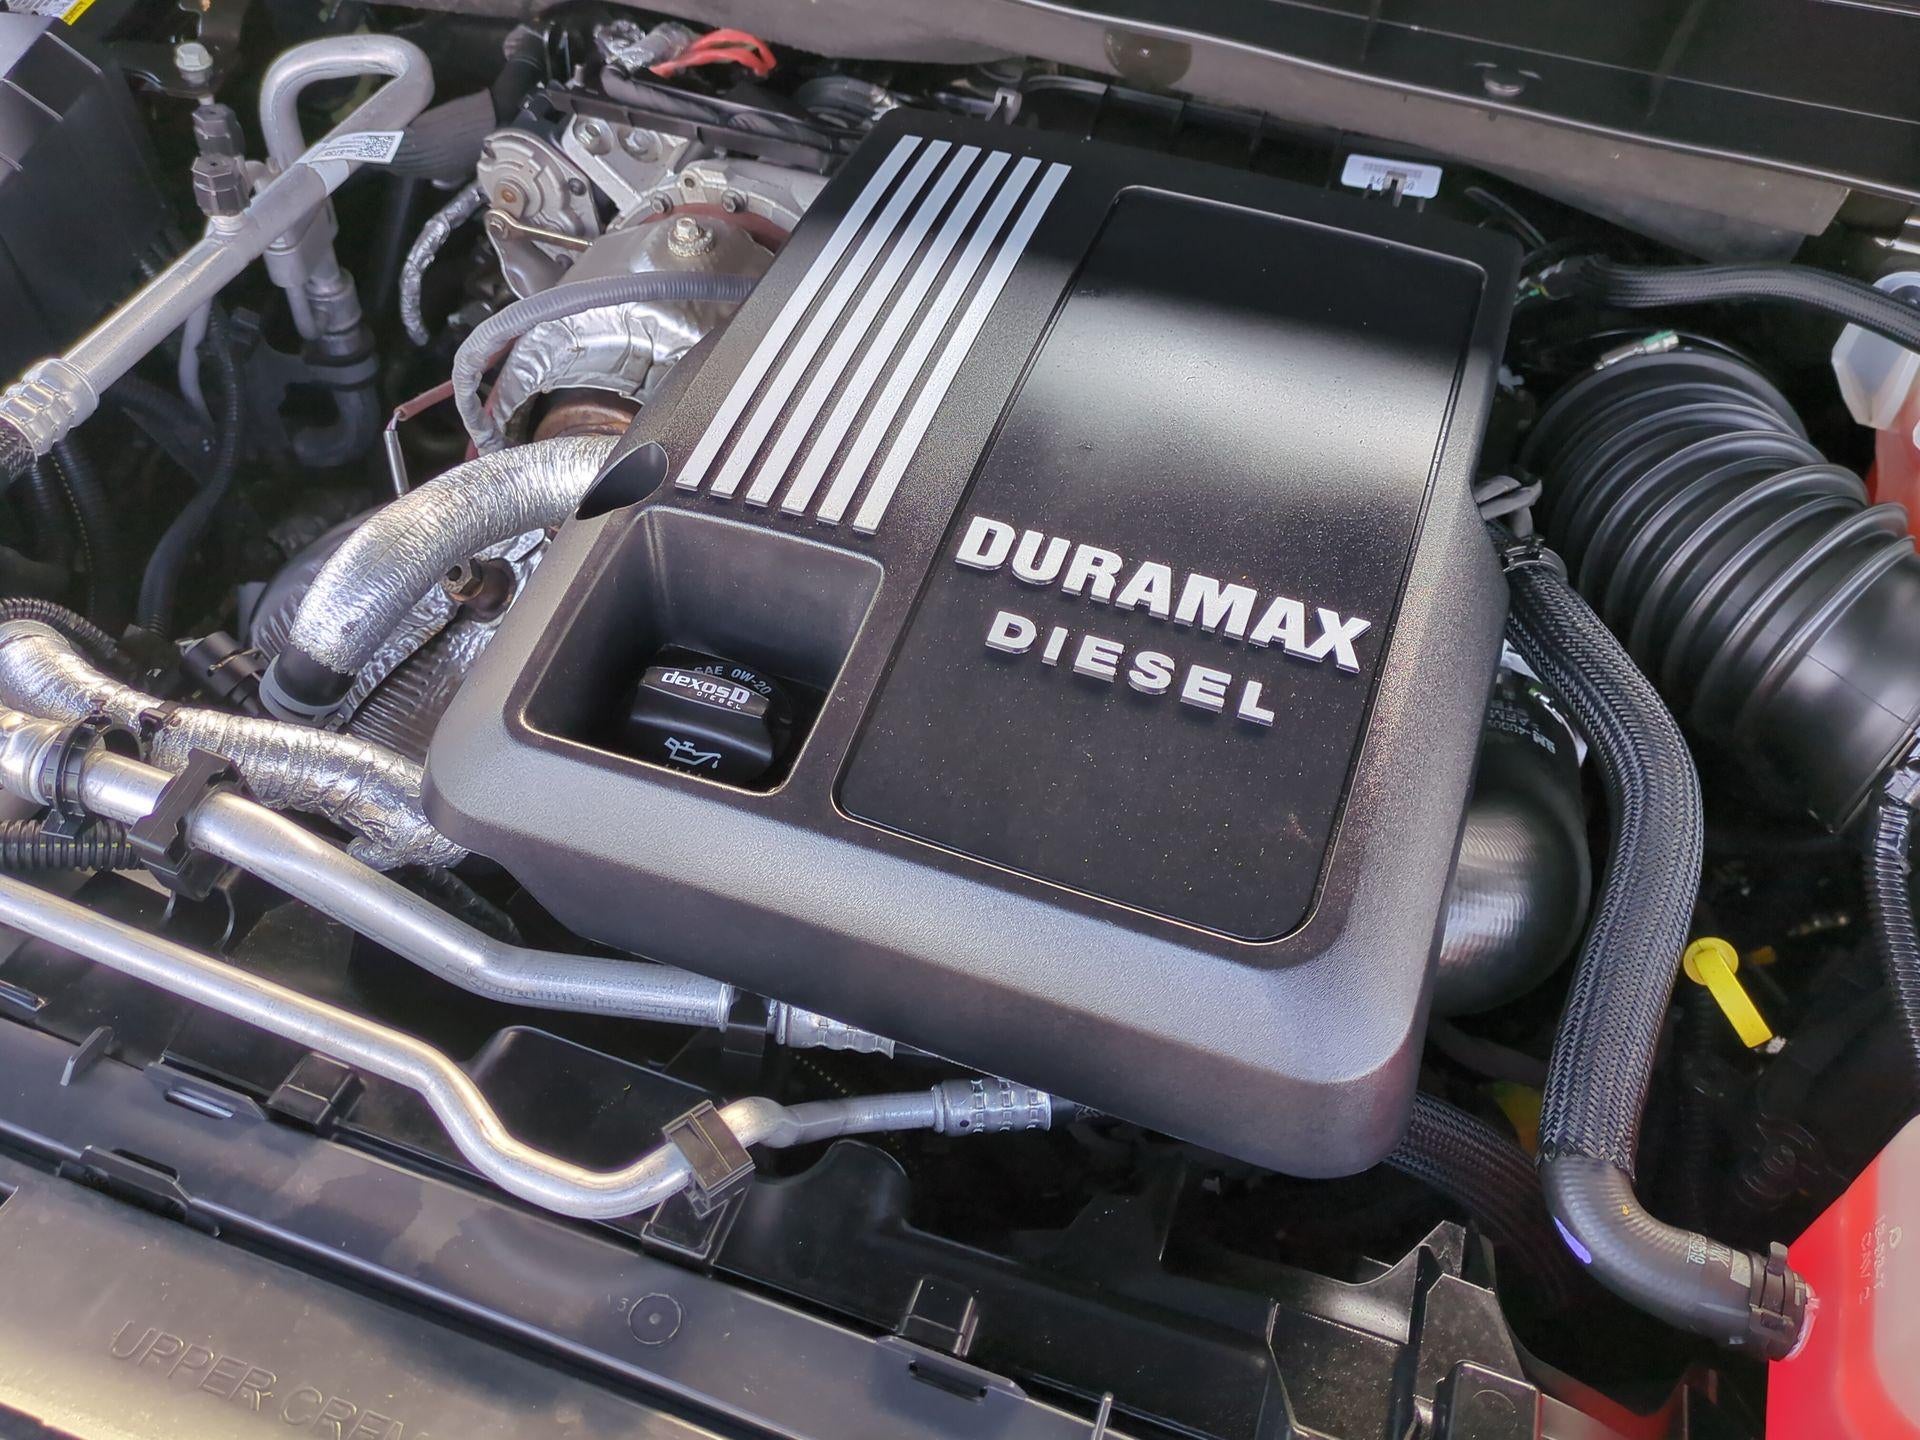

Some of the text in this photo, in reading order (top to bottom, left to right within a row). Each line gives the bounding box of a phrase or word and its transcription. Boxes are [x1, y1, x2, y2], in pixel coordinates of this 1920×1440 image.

[954, 516, 1371, 674] DURAMAX
[661, 671, 750, 704] dexosD
[694, 665, 772, 694] SAE 0W-20
[985, 611, 1275, 726] DIESEL
[696, 691, 742, 710] DIESEL
[112, 1319, 277, 1412] UPPER
